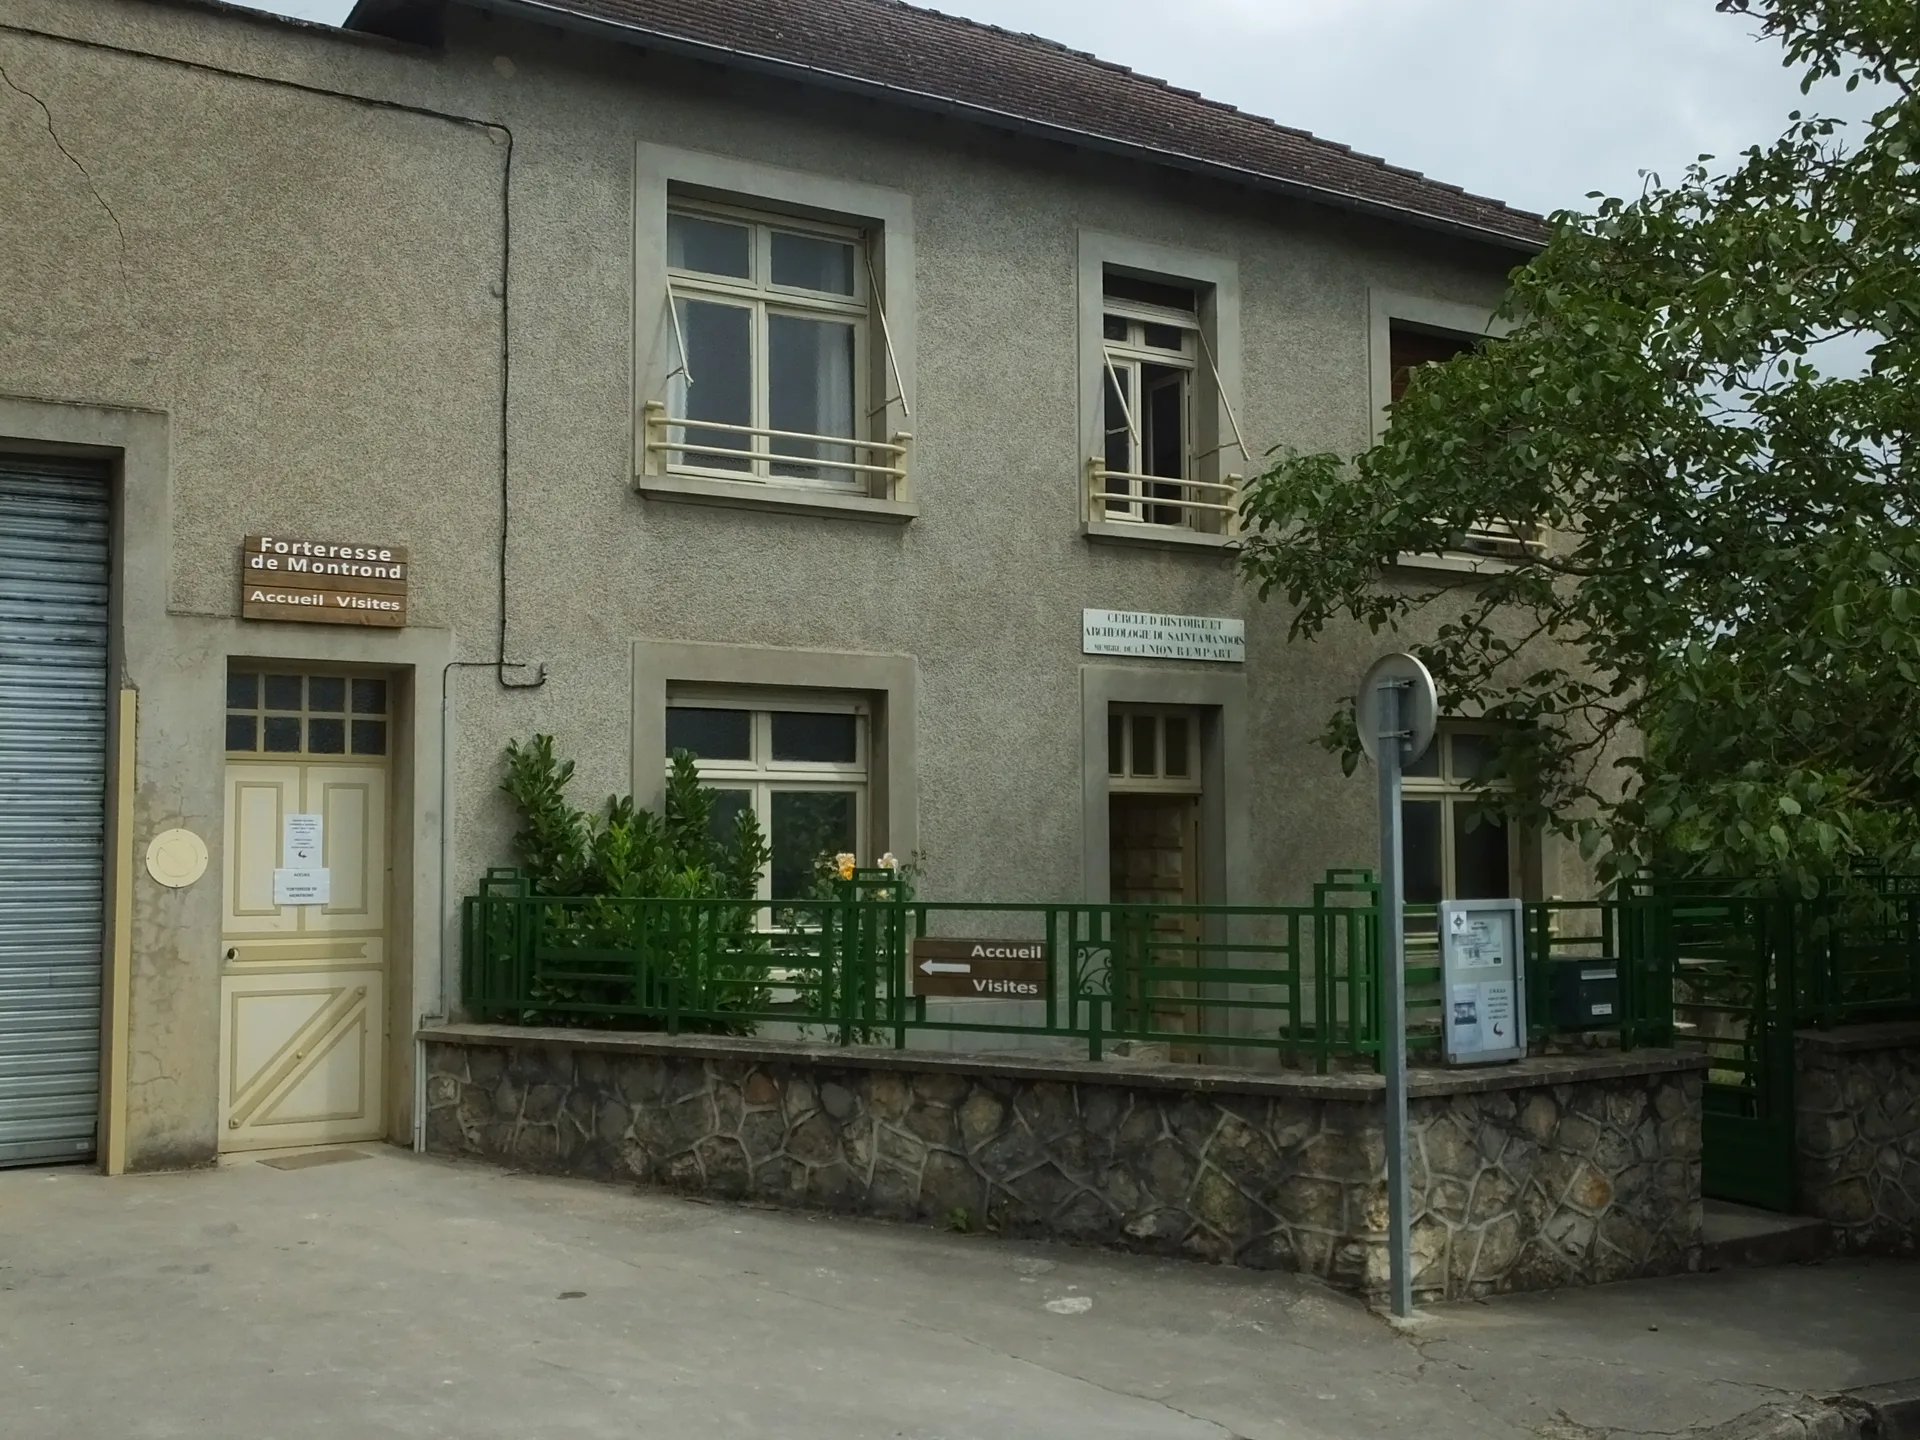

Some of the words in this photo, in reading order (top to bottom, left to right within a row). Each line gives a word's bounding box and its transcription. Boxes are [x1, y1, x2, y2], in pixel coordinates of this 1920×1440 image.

[261, 537, 392, 561] Forteresse
[251, 554, 279, 570] de
[287, 557, 401, 579] Montrond
[250, 590, 324, 606] Accueil
[336, 595, 400, 611] Visites
[1107, 613, 1148, 626] CERCLE
[1160, 616, 1208, 630] HISTOIRE
[1210, 620, 1224, 630] ET
[971, 944, 1042, 959] Accueil
[973, 979, 1039, 994] Visites
